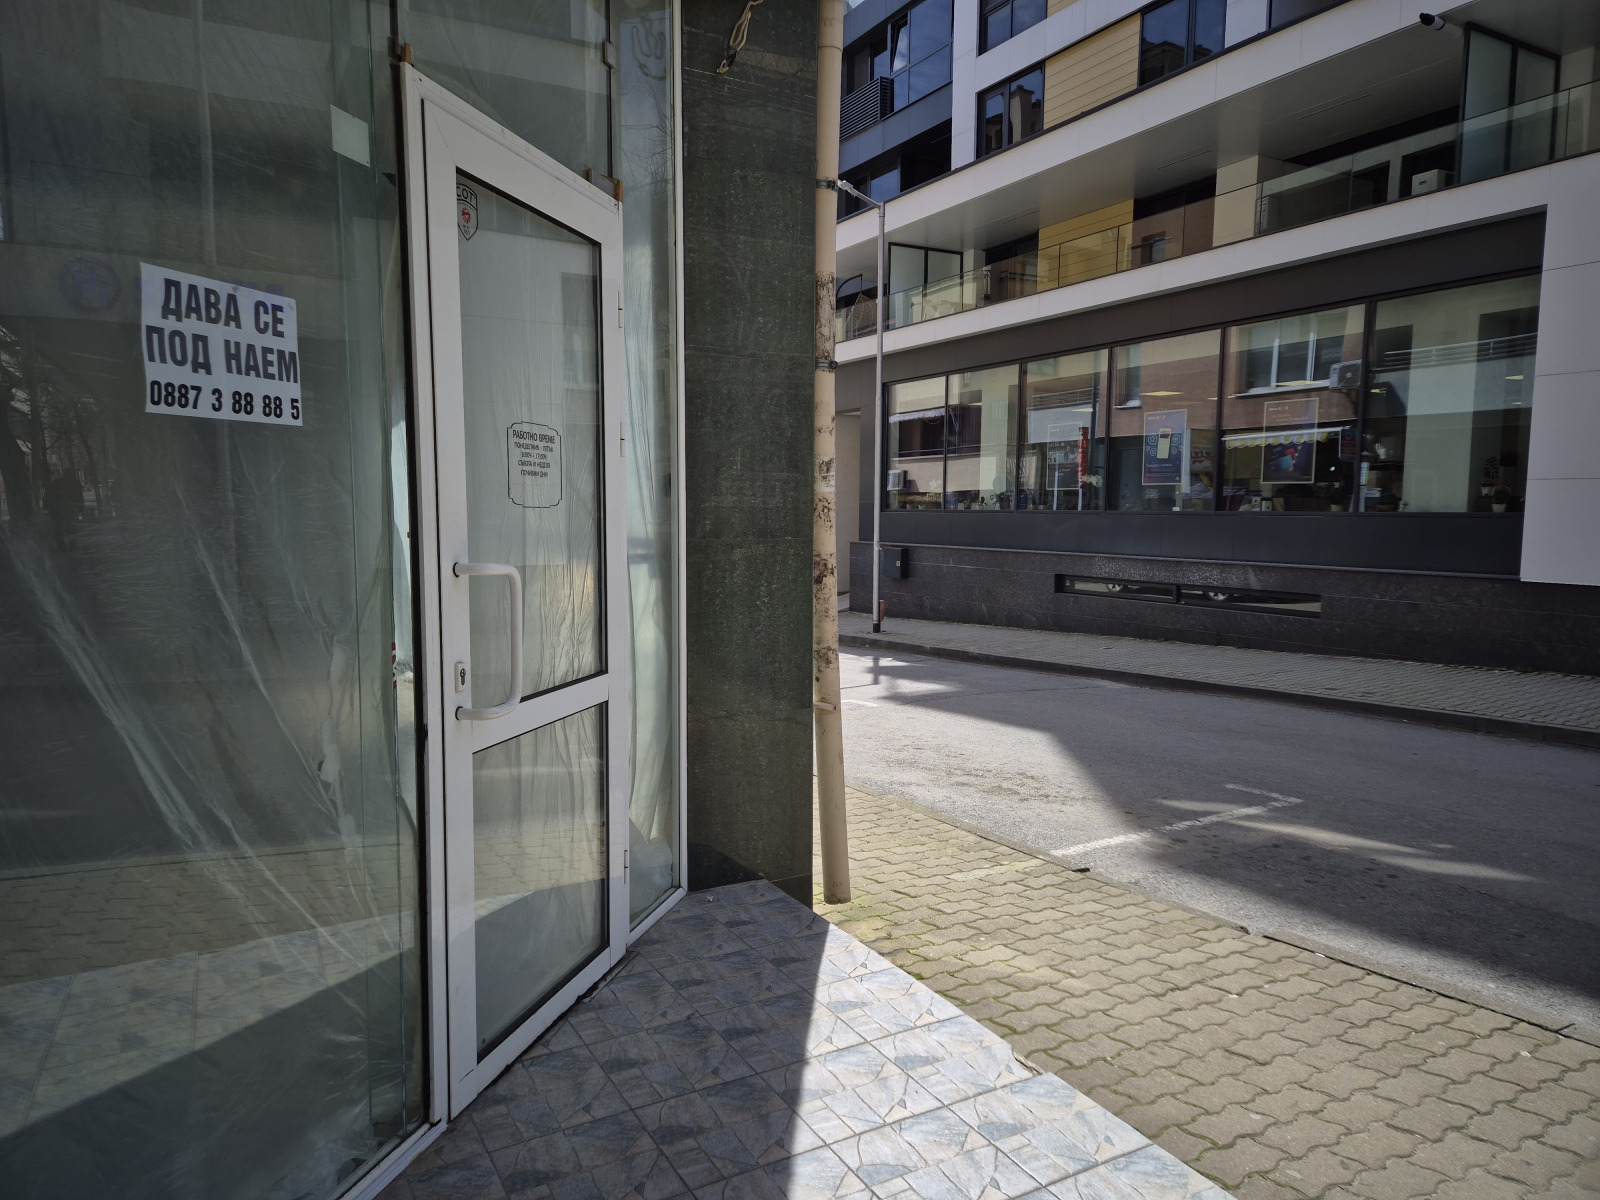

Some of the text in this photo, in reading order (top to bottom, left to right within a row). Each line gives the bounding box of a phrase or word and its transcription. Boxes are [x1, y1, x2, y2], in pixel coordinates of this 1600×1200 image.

[161, 277, 242, 329] ДАВА
[254, 300, 285, 338] СЕ
[145, 324, 298, 383] ПОД НАЕМ
[150, 380, 300, 420] 0887 3 88 88 5
[512, 430, 555, 444] РАБОТНО ВРЕМЕ
